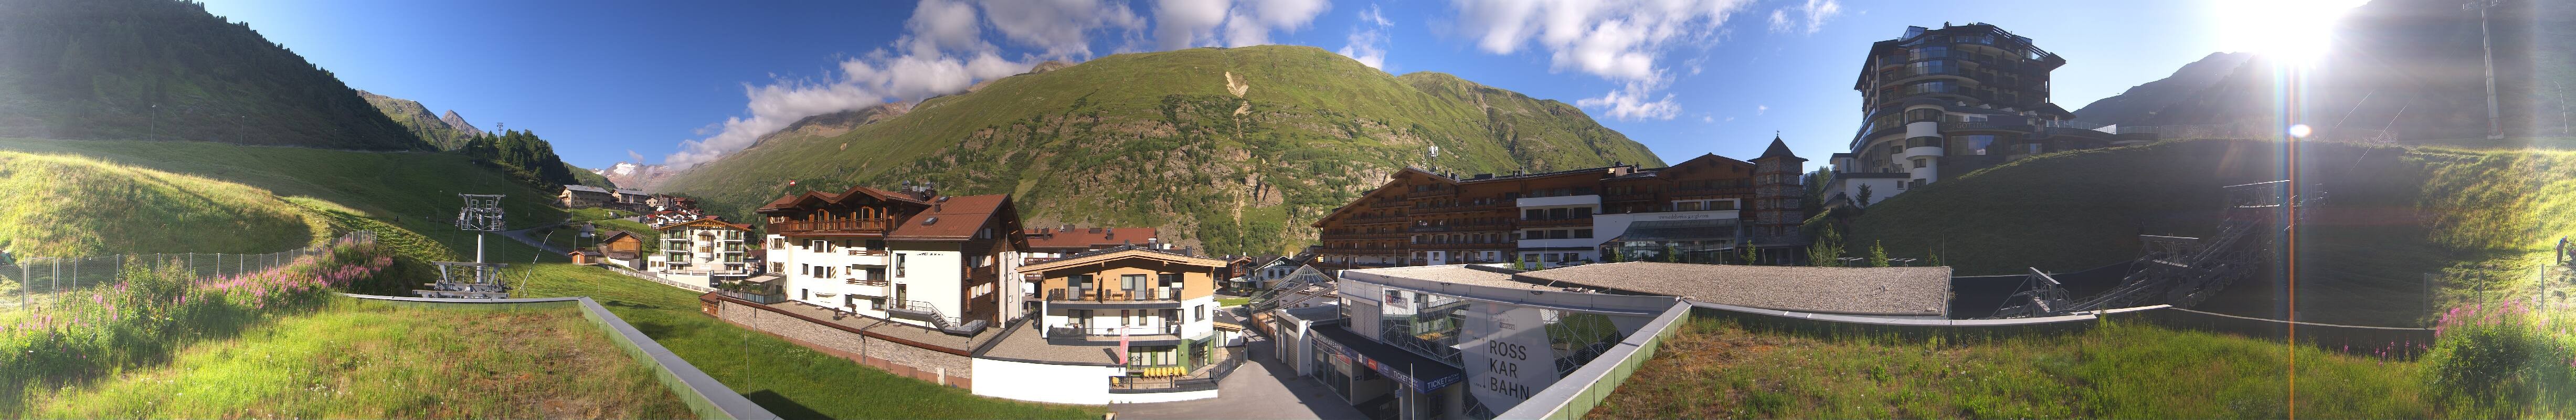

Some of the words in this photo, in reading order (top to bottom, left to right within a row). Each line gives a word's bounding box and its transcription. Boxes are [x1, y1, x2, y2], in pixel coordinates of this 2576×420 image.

[1393, 298, 1407, 307] GURGL
[1318, 334, 1342, 352] ROSSKARBAHN
[1490, 340, 1526, 361] ROSS
[1393, 370, 1408, 383] TICKET
[1490, 358, 1517, 379] KAR
[1427, 376, 1448, 389] TICKET
[1491, 376, 1529, 400] BAHN
